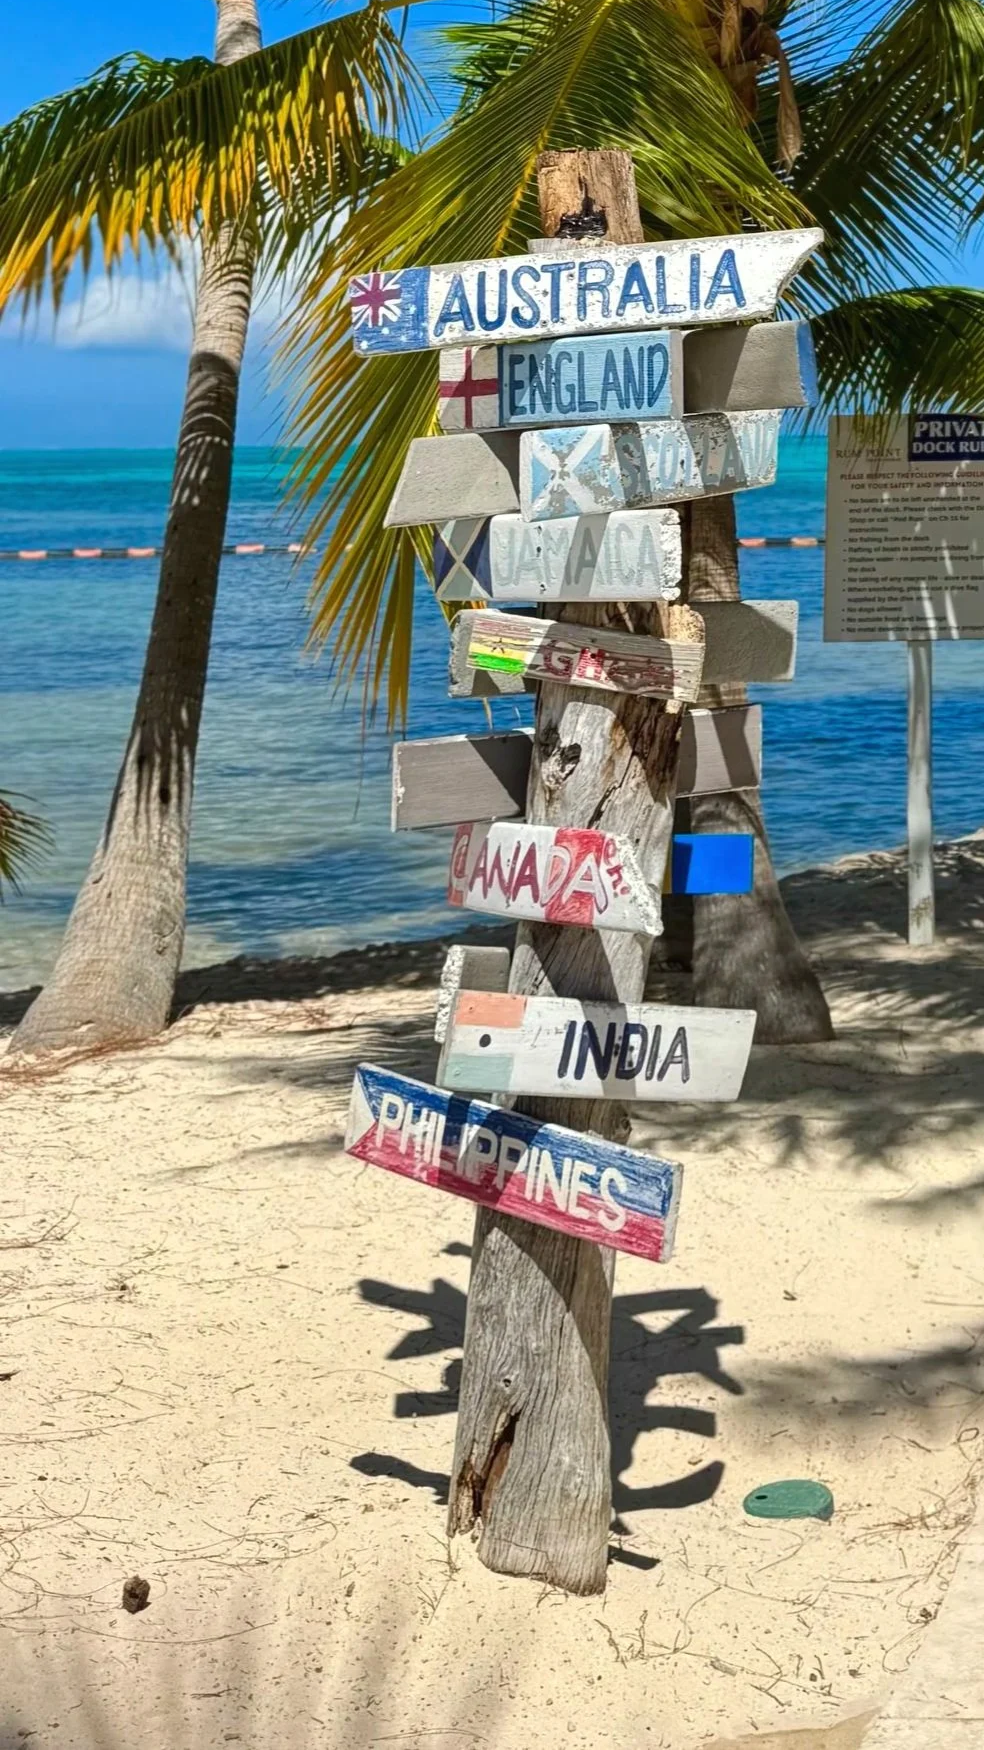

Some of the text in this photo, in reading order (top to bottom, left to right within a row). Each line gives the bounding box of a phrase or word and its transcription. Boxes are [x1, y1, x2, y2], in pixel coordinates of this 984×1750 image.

[433, 249, 747, 337] AUSTRALIA
[509, 343, 669, 415] ENGLAND
[866, 472, 895, 480] RESPECT
[896, 471, 909, 479] THE
[910, 471, 953, 479] FOLLOWING
[912, 442, 956, 454] DOCK
[851, 482, 865, 490] FOR
[867, 482, 888, 490] YOUR
[933, 480, 984, 488] INFORMATION
[492, 523, 662, 586] JAMAICA
[452, 836, 608, 914] CANADA
[557, 1020, 690, 1084] INDIA
[375, 1093, 628, 1232] PHILIPPINES
